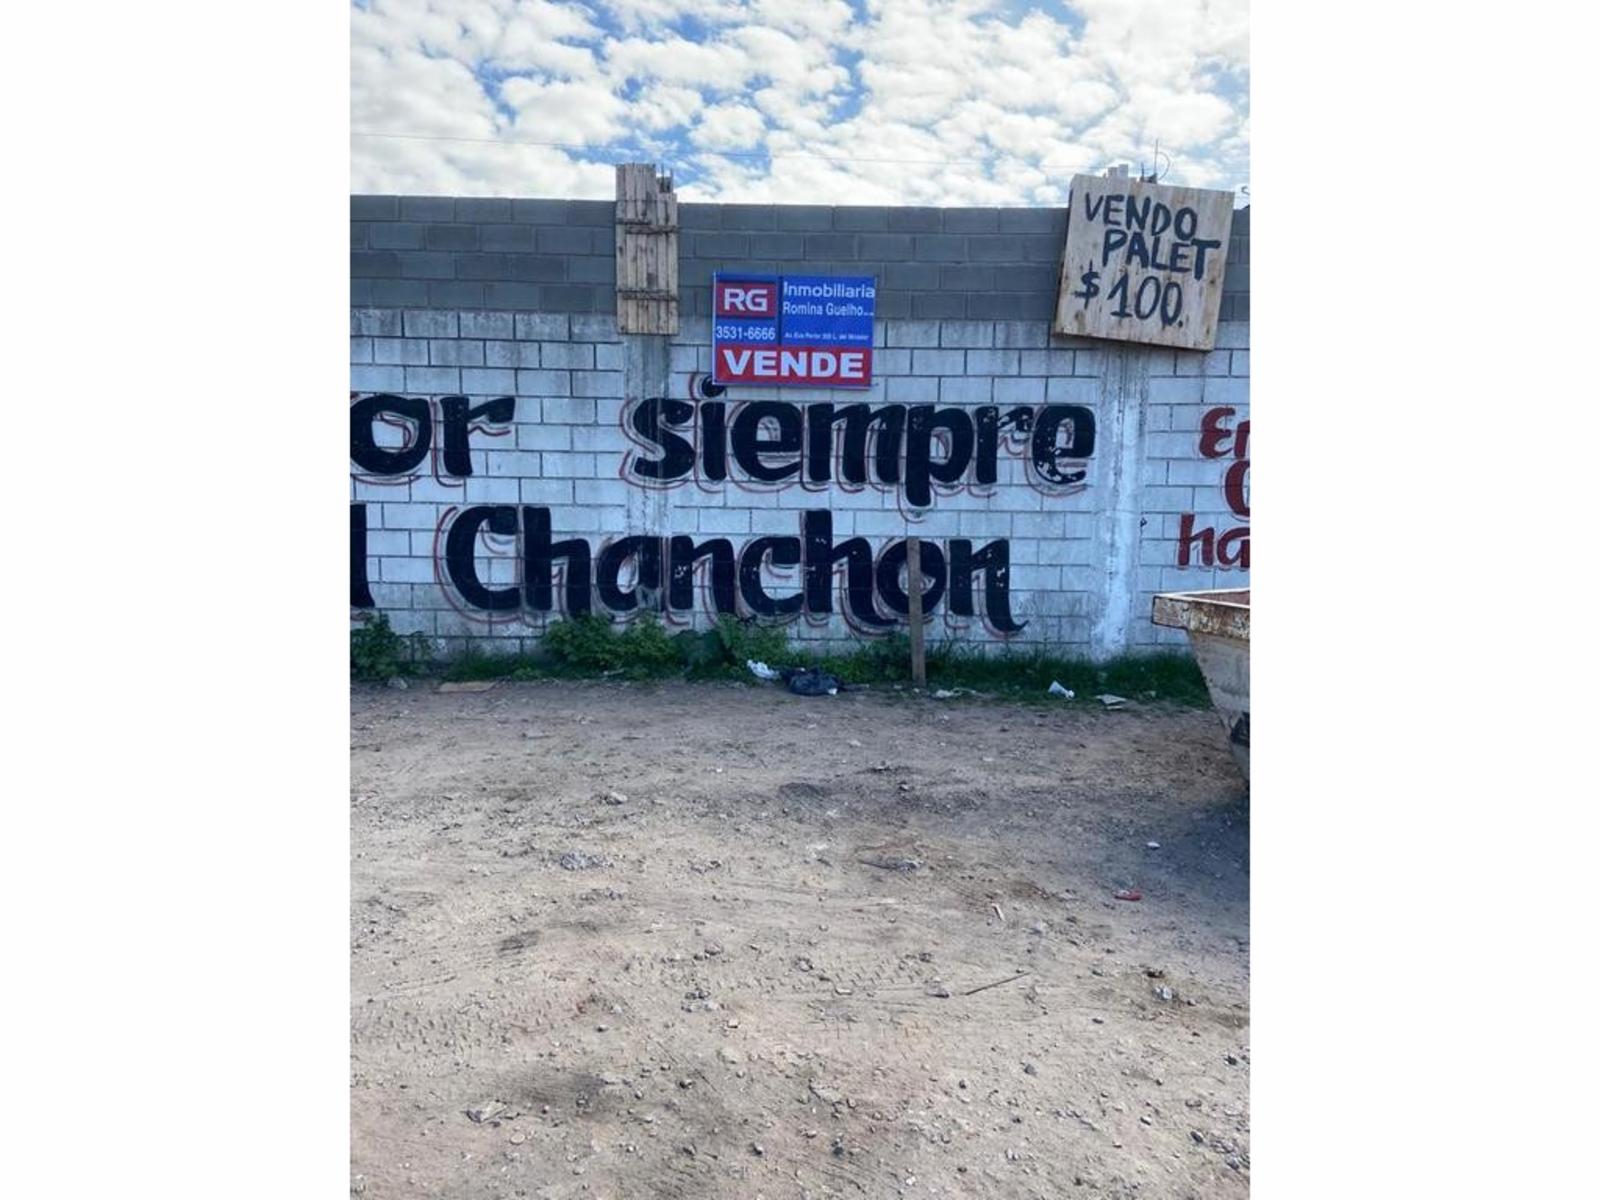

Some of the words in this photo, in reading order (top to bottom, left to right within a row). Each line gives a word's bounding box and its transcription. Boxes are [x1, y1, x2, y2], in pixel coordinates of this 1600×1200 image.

[1085, 191, 1199, 242] VENDO
[1102, 228, 1222, 281] PALET
[723, 287, 769, 313] RG
[783, 281, 876, 299] Inmobiliaria
[782, 301, 823, 316] Romina
[715, 325, 777, 341] 3531-6666
[722, 349, 865, 379] VENDE
[632, 375, 1096, 507] siempre
[445, 505, 1029, 632] Chanchon
